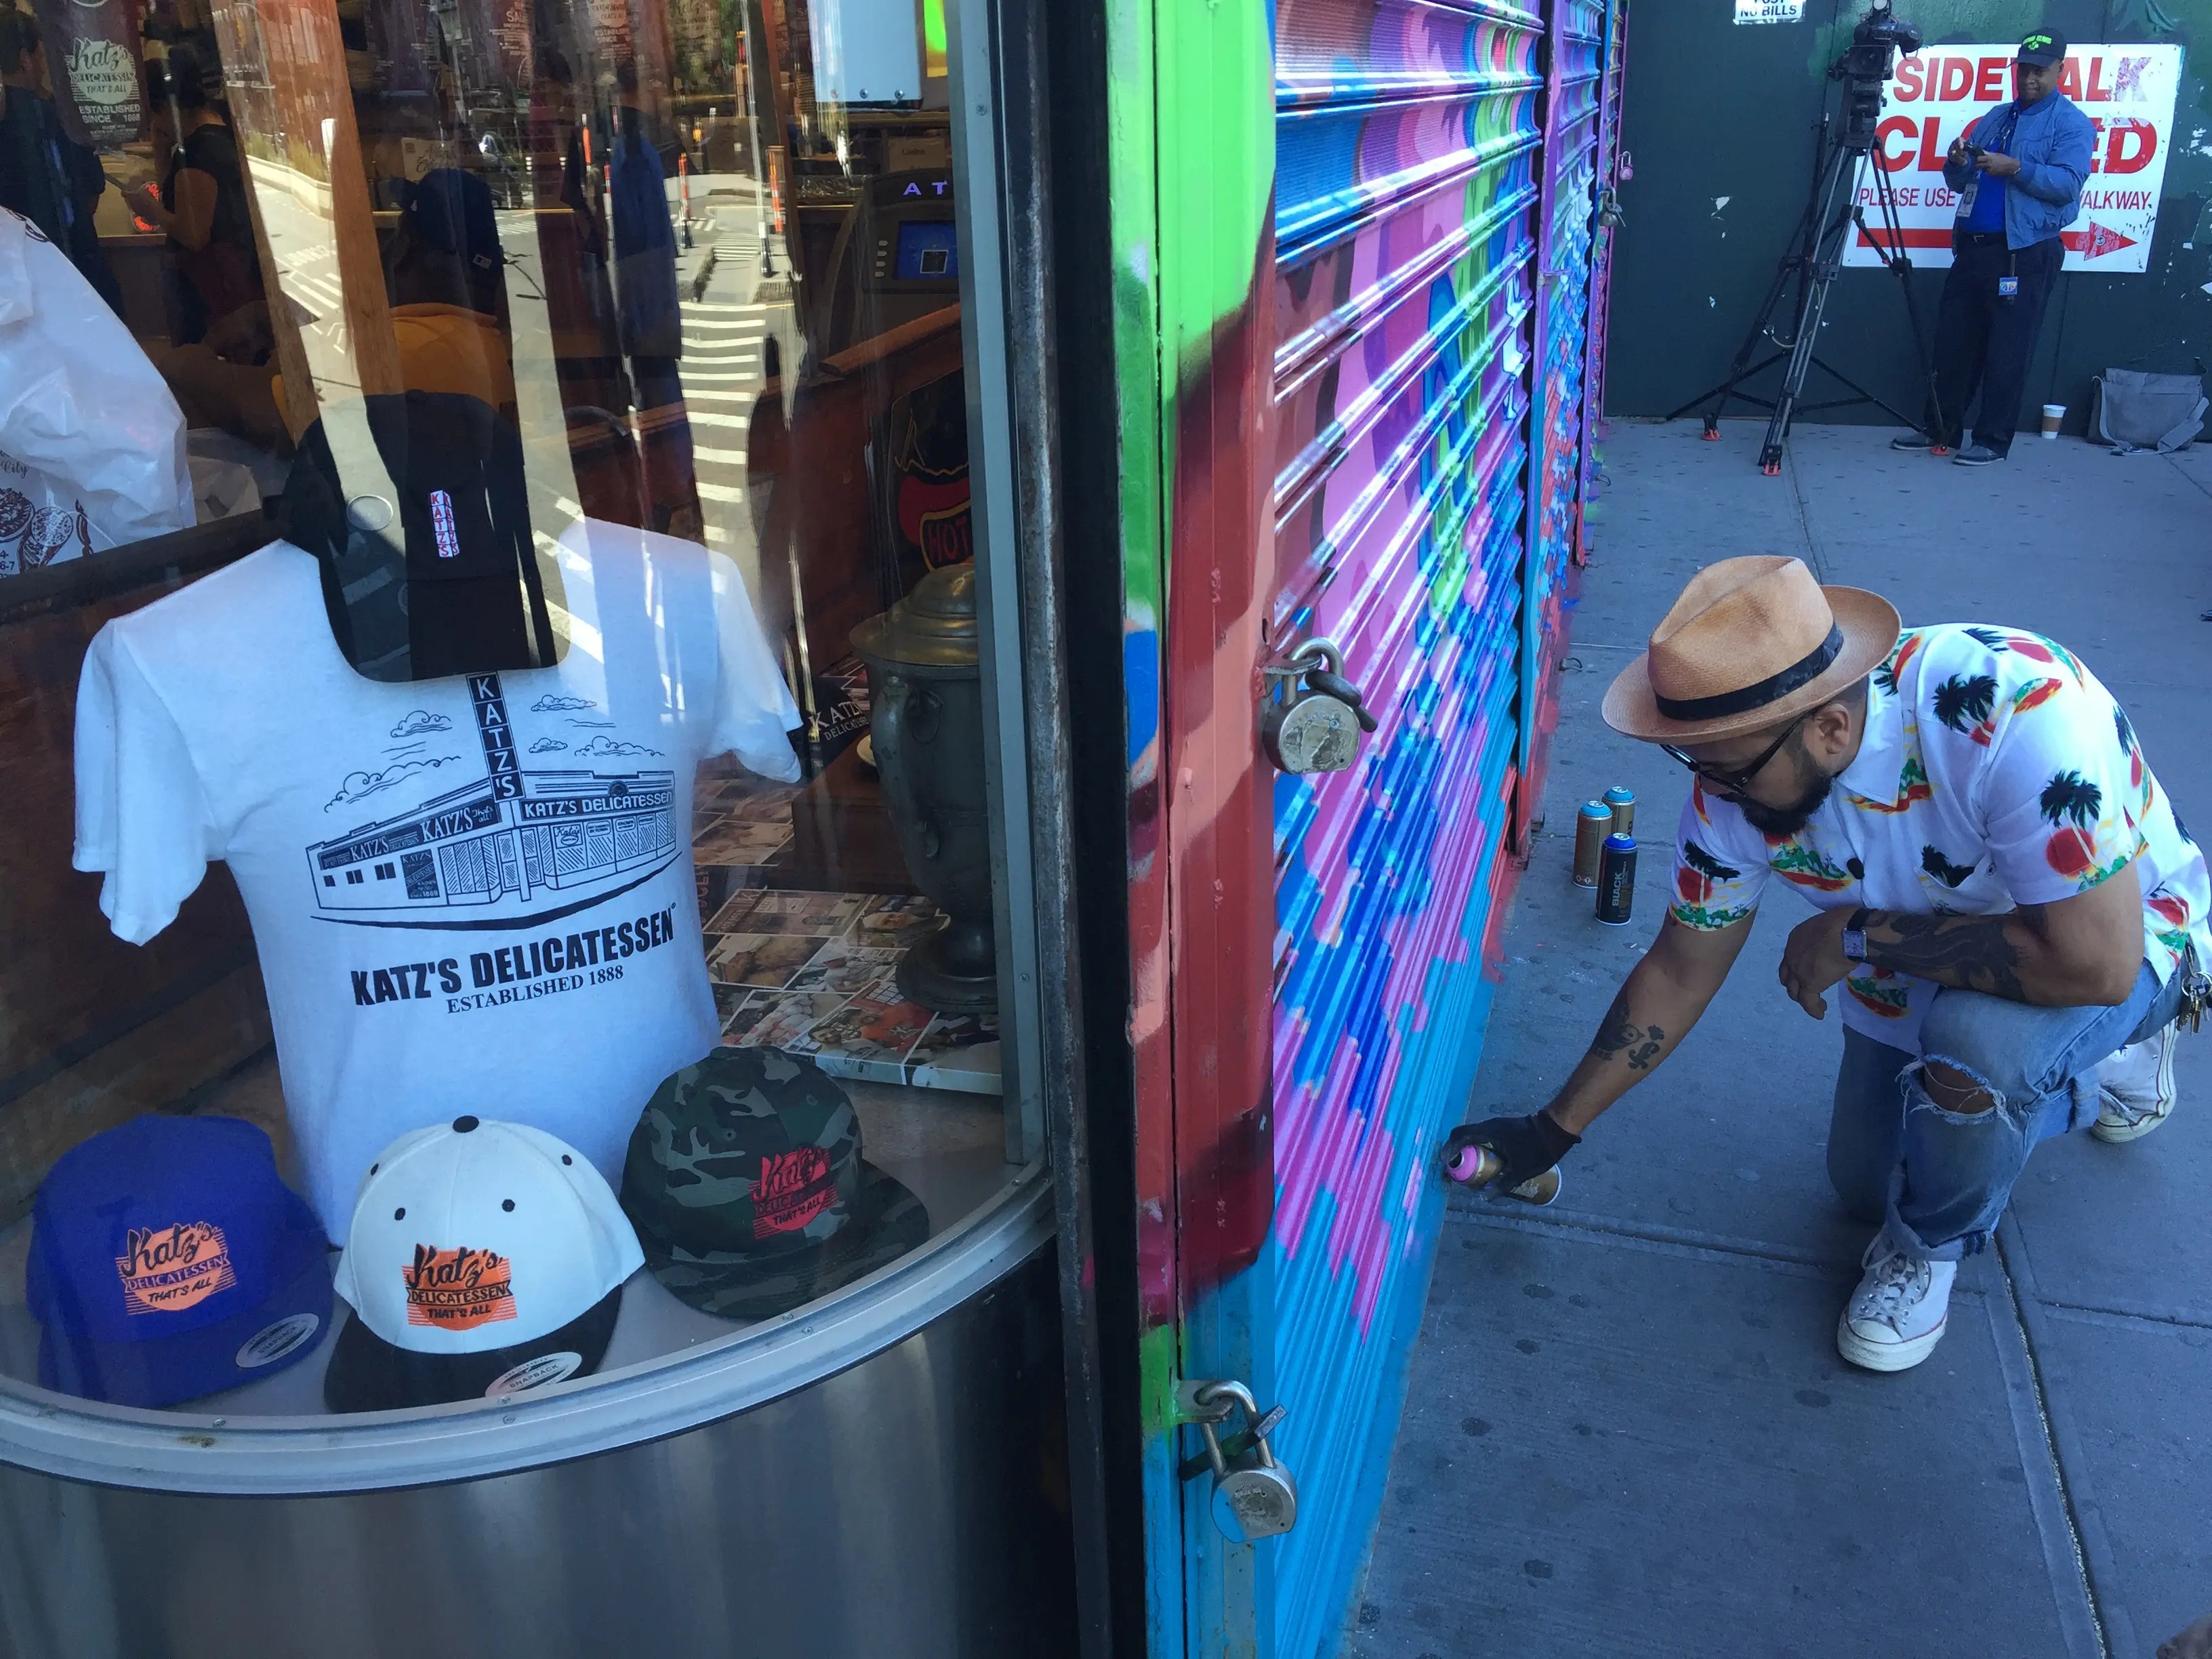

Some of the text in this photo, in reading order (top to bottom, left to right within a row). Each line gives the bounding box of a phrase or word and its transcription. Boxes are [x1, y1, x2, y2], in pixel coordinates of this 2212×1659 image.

[1740, 5, 1797, 17] NO BILLS
[1893, 56, 2152, 102] SIDEALK
[78, 104, 141, 115] ESTABLISHED
[82, 115, 112, 124] SINCE
[1875, 115, 2158, 174] CLD
[1859, 187, 2152, 209] PLEASE USE ALKWAY
[475, 676, 518, 798] KATZ'S
[525, 791, 673, 817] KATZ'S DELICATESSEN
[350, 836, 390, 861] KATZ'S
[419, 807, 474, 842] KATZ'S
[1612, 872, 1622, 907] BLACK
[350, 912, 674, 1006] KATZ'S DELICATESSEN
[447, 964, 624, 1015] ESTABLISHED 1888
[120, 1221, 216, 1277] Katz's
[407, 1243, 504, 1288] Katz's
[128, 1255, 224, 1290] DELICATESSEN
[148, 1277, 212, 1303] THAT'S ALL
[411, 1283, 506, 1304] DELICATESSEN
[427, 1303, 492, 1319] THAT'S ALL
[509, 1364, 559, 1389] SNAPBACK
